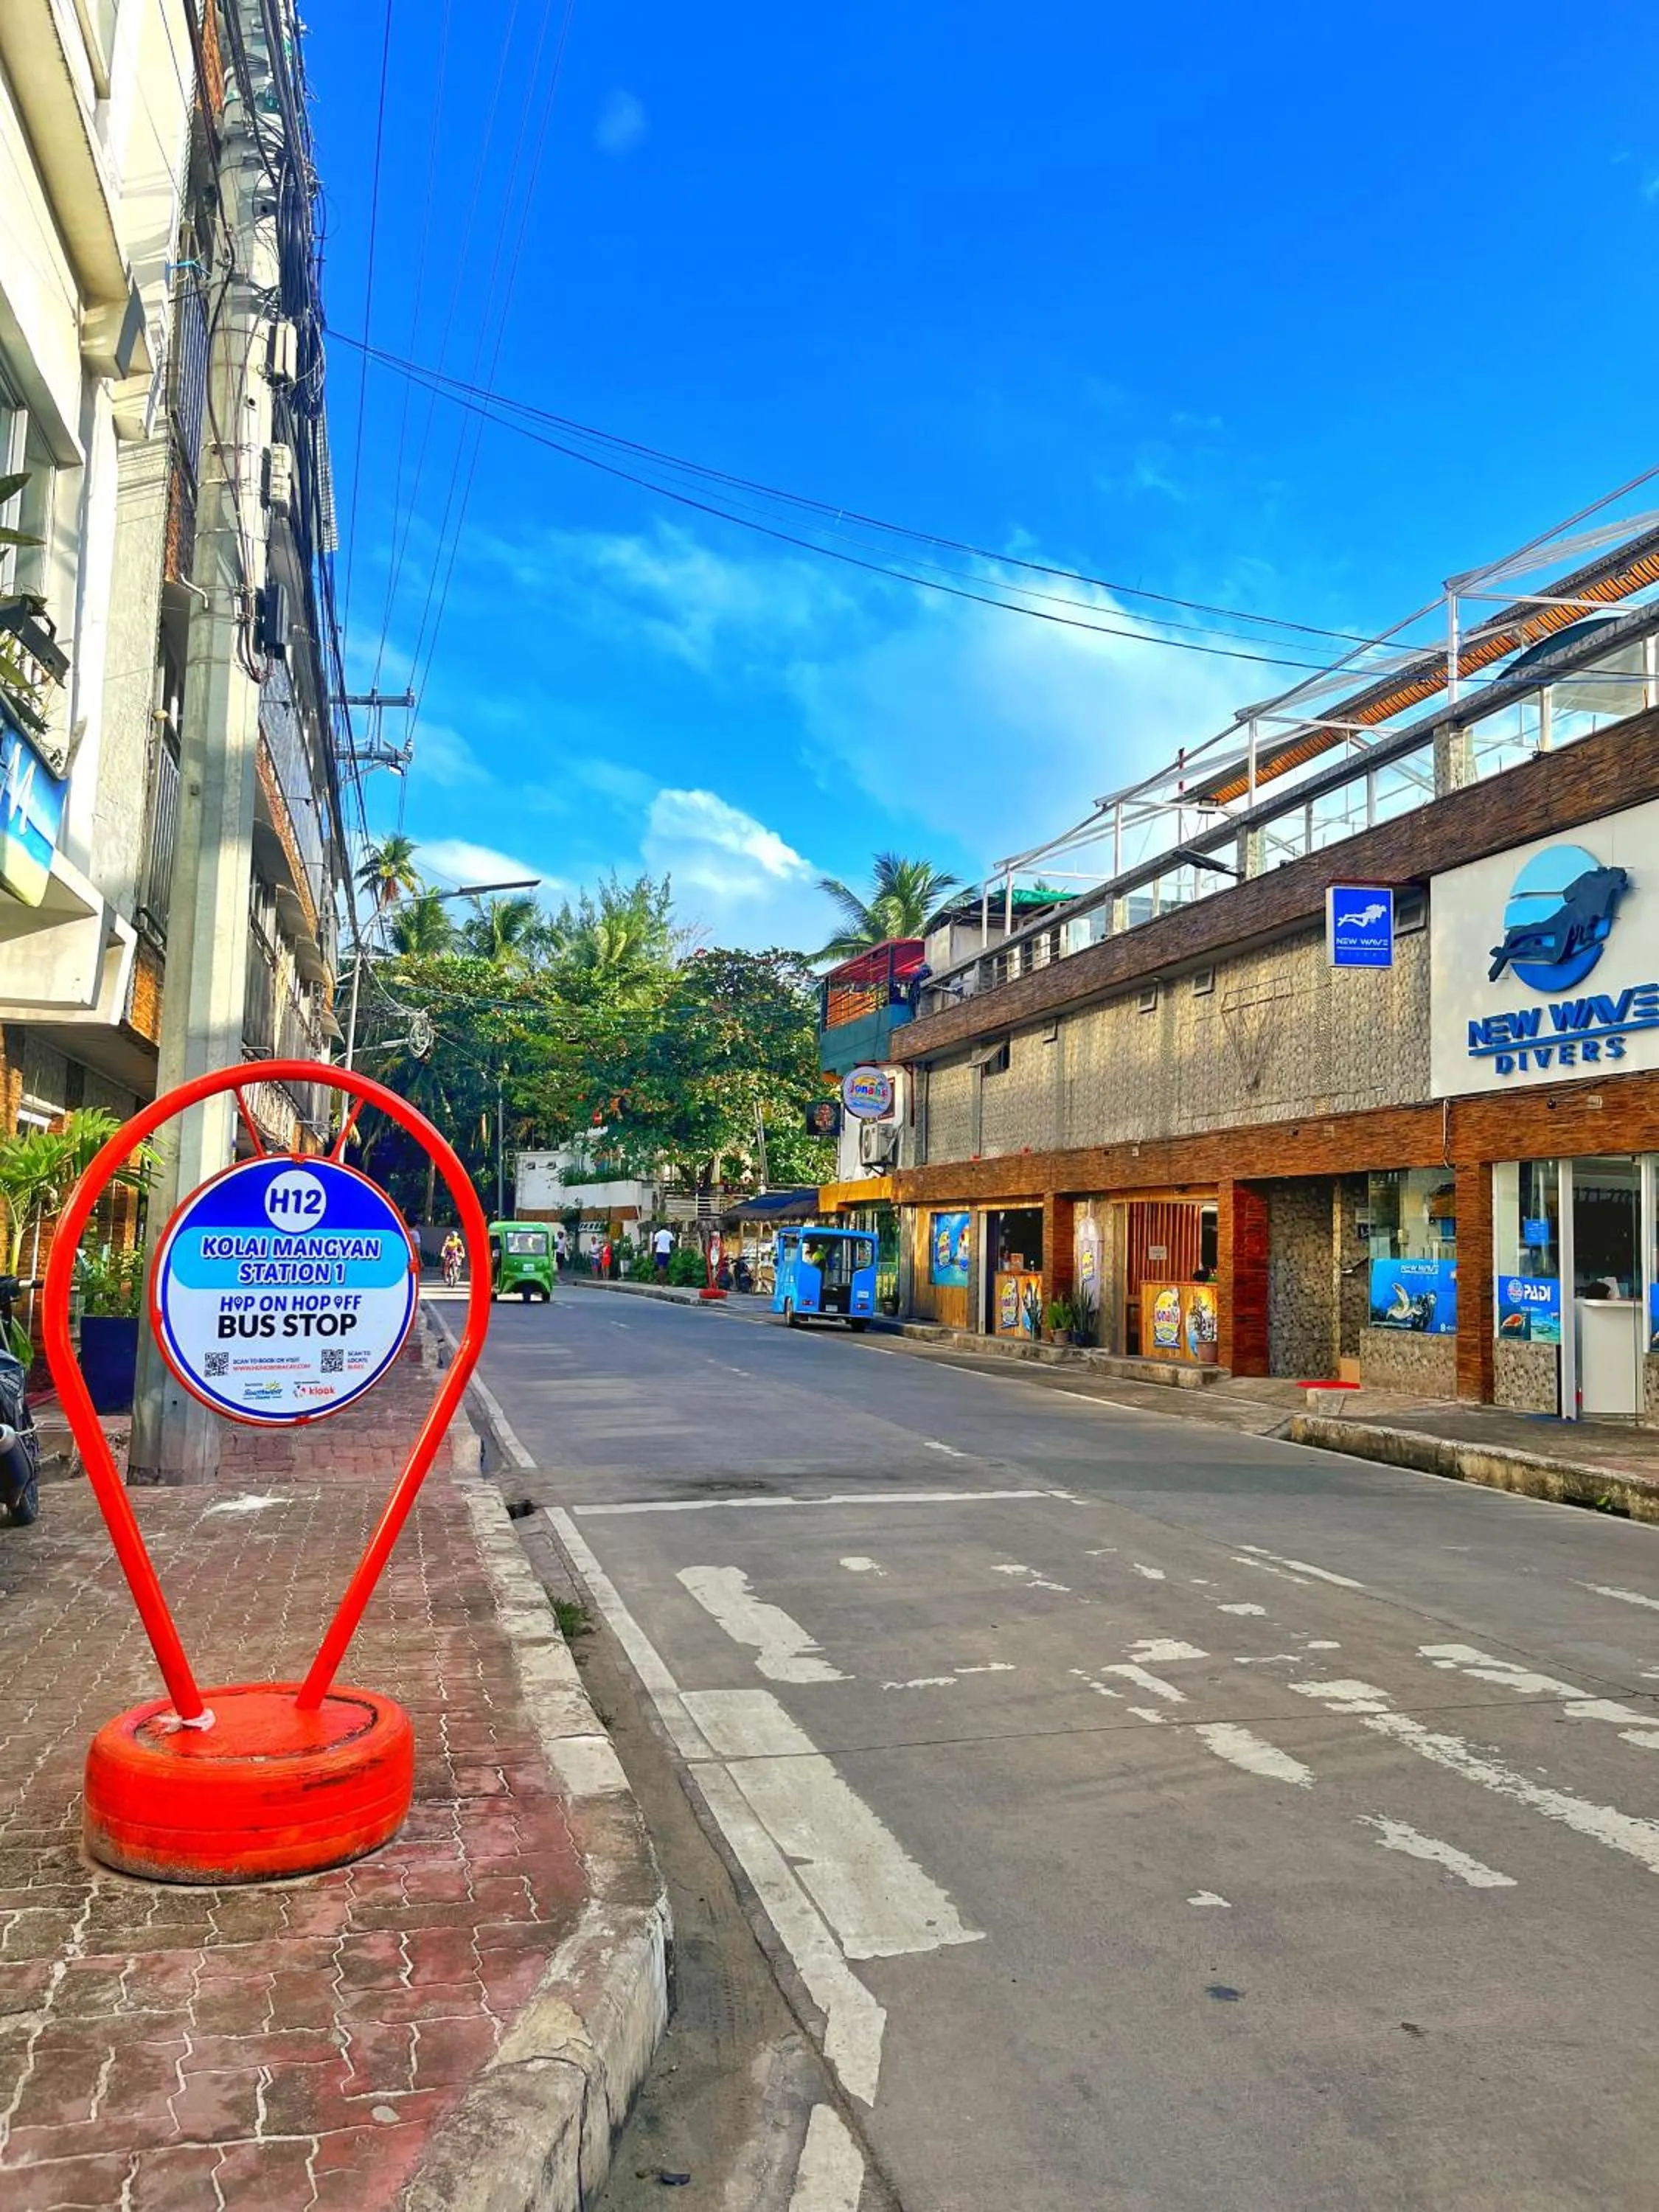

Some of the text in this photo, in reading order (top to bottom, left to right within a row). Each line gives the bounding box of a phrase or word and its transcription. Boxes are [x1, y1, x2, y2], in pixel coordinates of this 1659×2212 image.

[1468, 983, 1659, 1047] NEW WAVE
[1495, 1036, 1627, 1074] DIVERS
[269, 1189, 322, 1214] H12
[202, 1237, 382, 1259] KOLAI MANGYAN
[238, 1263, 347, 1285] STATION 1
[220, 1295, 362, 1312] HOP ON HOP OFF
[1523, 1284, 1551, 1301] PADI
[218, 1313, 358, 1338] BUS STOP
